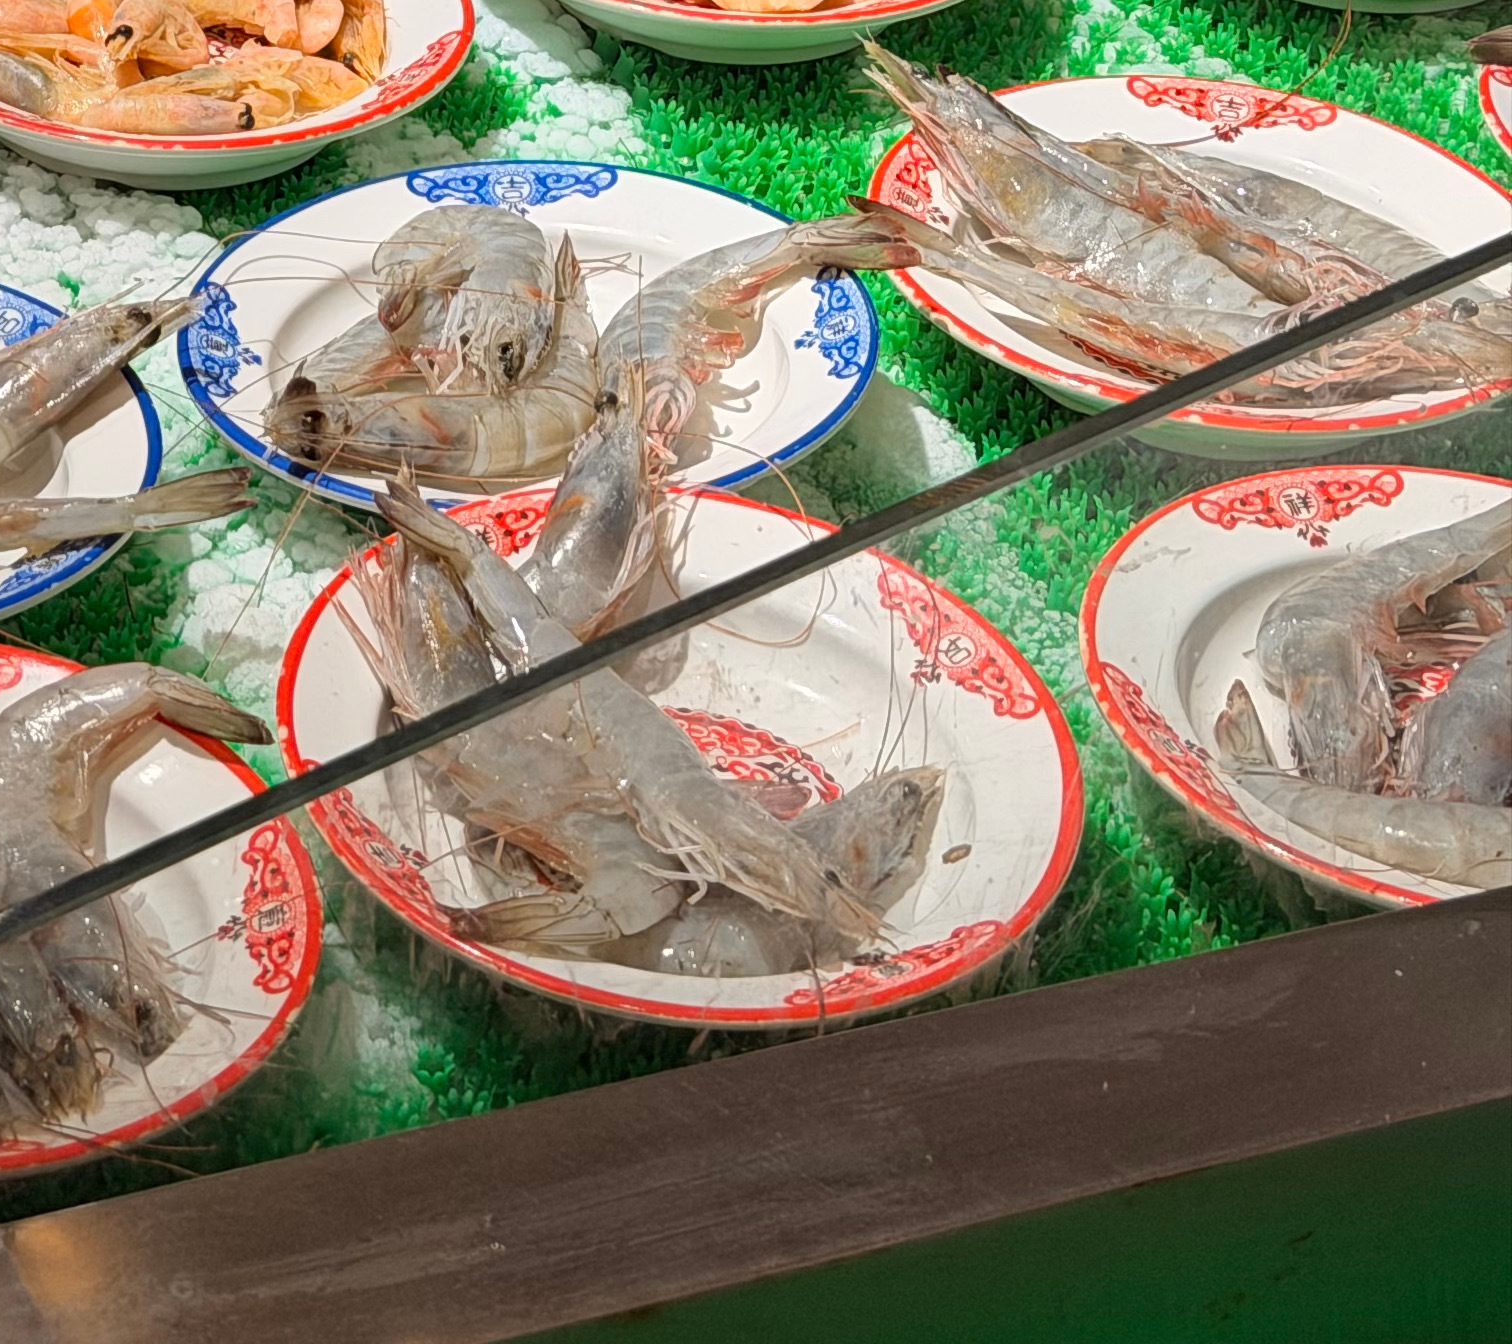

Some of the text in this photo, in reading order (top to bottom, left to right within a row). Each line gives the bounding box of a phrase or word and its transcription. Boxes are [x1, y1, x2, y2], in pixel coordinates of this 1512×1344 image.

[1218, 96, 1243, 119] 吉
[498, 176, 526, 198] 吉
[1282, 491, 1317, 518] 祥
[939, 637, 973, 664] 如
